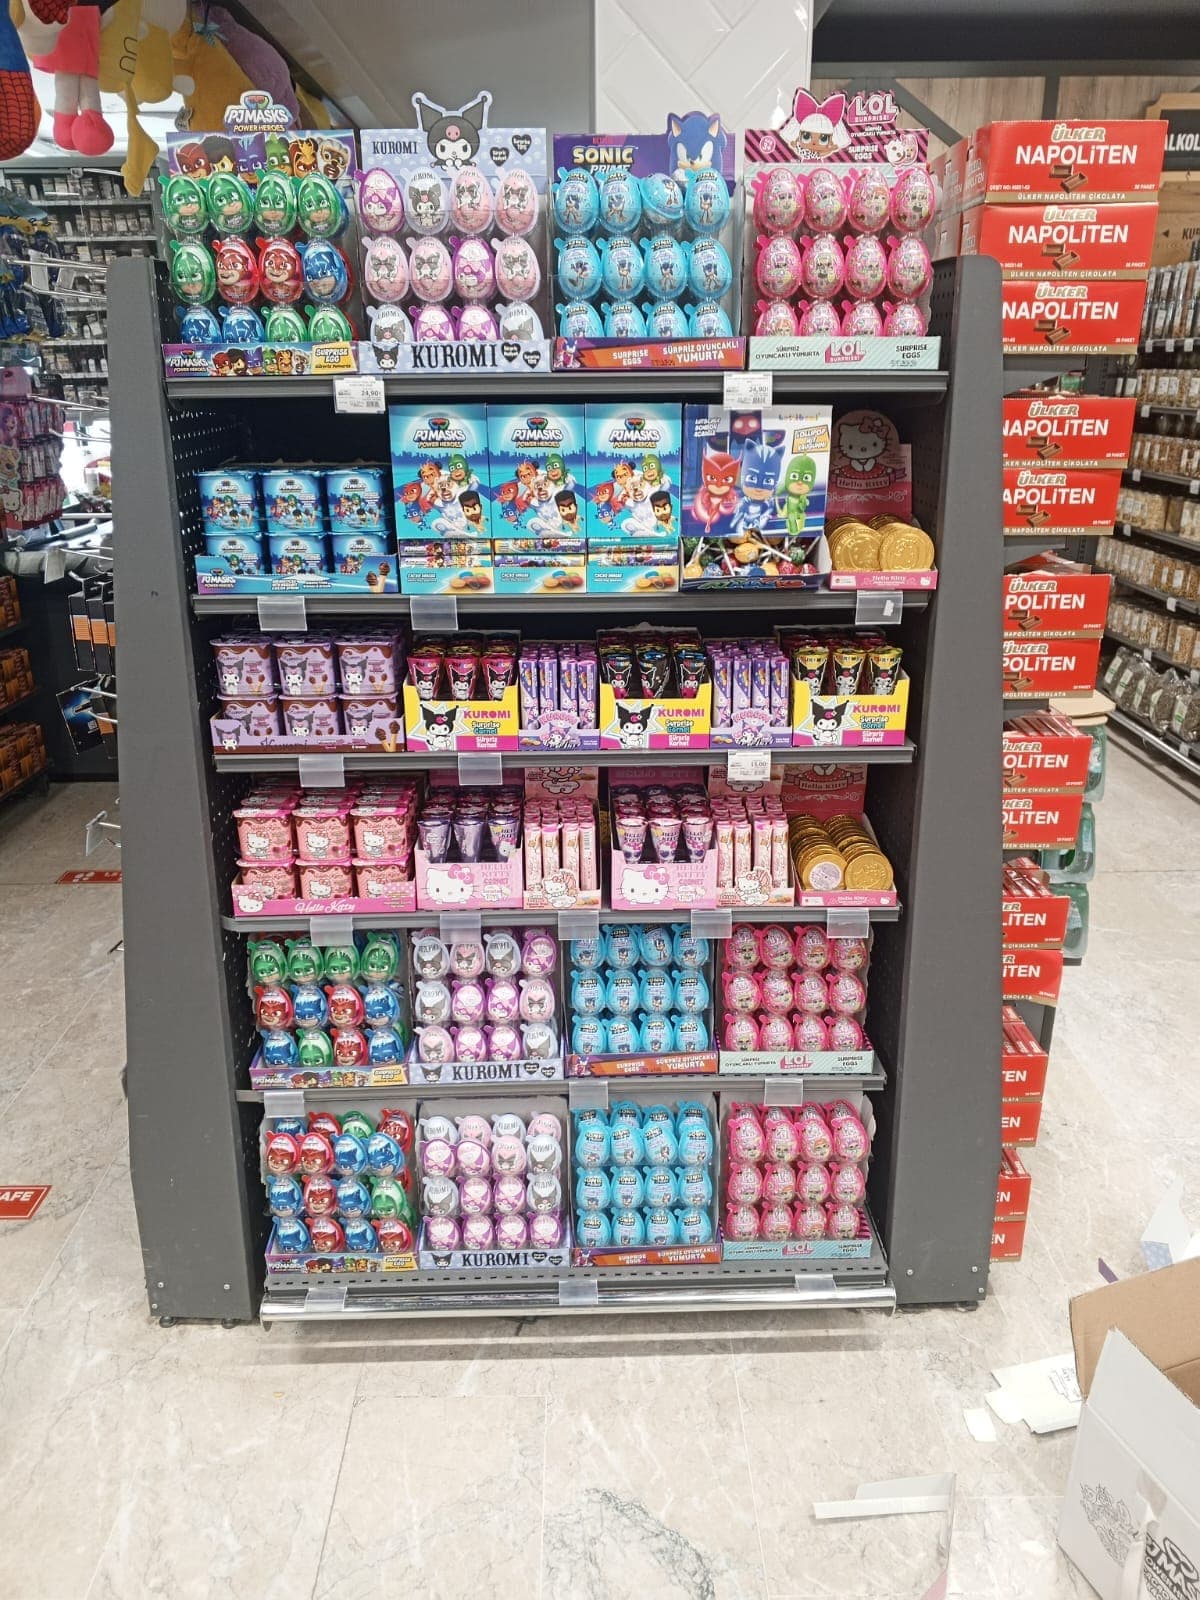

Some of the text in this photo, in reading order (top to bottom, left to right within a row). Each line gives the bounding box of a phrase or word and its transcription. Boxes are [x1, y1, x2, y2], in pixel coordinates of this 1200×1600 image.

[855, 94, 898, 115] LOL
[1052, 124, 1105, 142] ÜLKER
[373, 141, 418, 154] KUROMI
[848, 145, 878, 153] SURPRISE
[573, 147, 633, 164] SONIC
[854, 152, 872, 160] EGGS
[1045, 207, 1096, 222] ÜLKER
[1036, 283, 1088, 299] ÜLKER
[315, 348, 348, 356] SURPRISE
[696, 341, 739, 352] OYUNCAKLI
[830, 342, 866, 356] LOL
[896, 344, 927, 352] SURPRISE
[324, 355, 340, 363] EGG
[412, 344, 498, 368] KUROMI
[613, 350, 648, 360] SURPRISE
[677, 351, 724, 363] YUMURTA
[902, 351, 920, 359] EGGS
[623, 358, 641, 366] EGGS
[1029, 401, 1079, 417] ÜLKER
[1018, 472, 1066, 485] ÜLKER
[1010, 579, 1056, 592] ÜLKER
[658, 709, 704, 717] KUROMI
[853, 704, 900, 713] KUROMI
[464, 710, 511, 719] KUROMI
[472, 721, 500, 729] Surprise
[665, 719, 694, 727] Surprise
[473, 727, 497, 735] Cornet
[295, 899, 355, 913] Hello Kitty
[667, 1061, 704, 1069] YUMURTA
[452, 1063, 521, 1081] KUROMI
[0, 1191, 35, 1202] AFE
[462, 1252, 530, 1266] KUROMI
